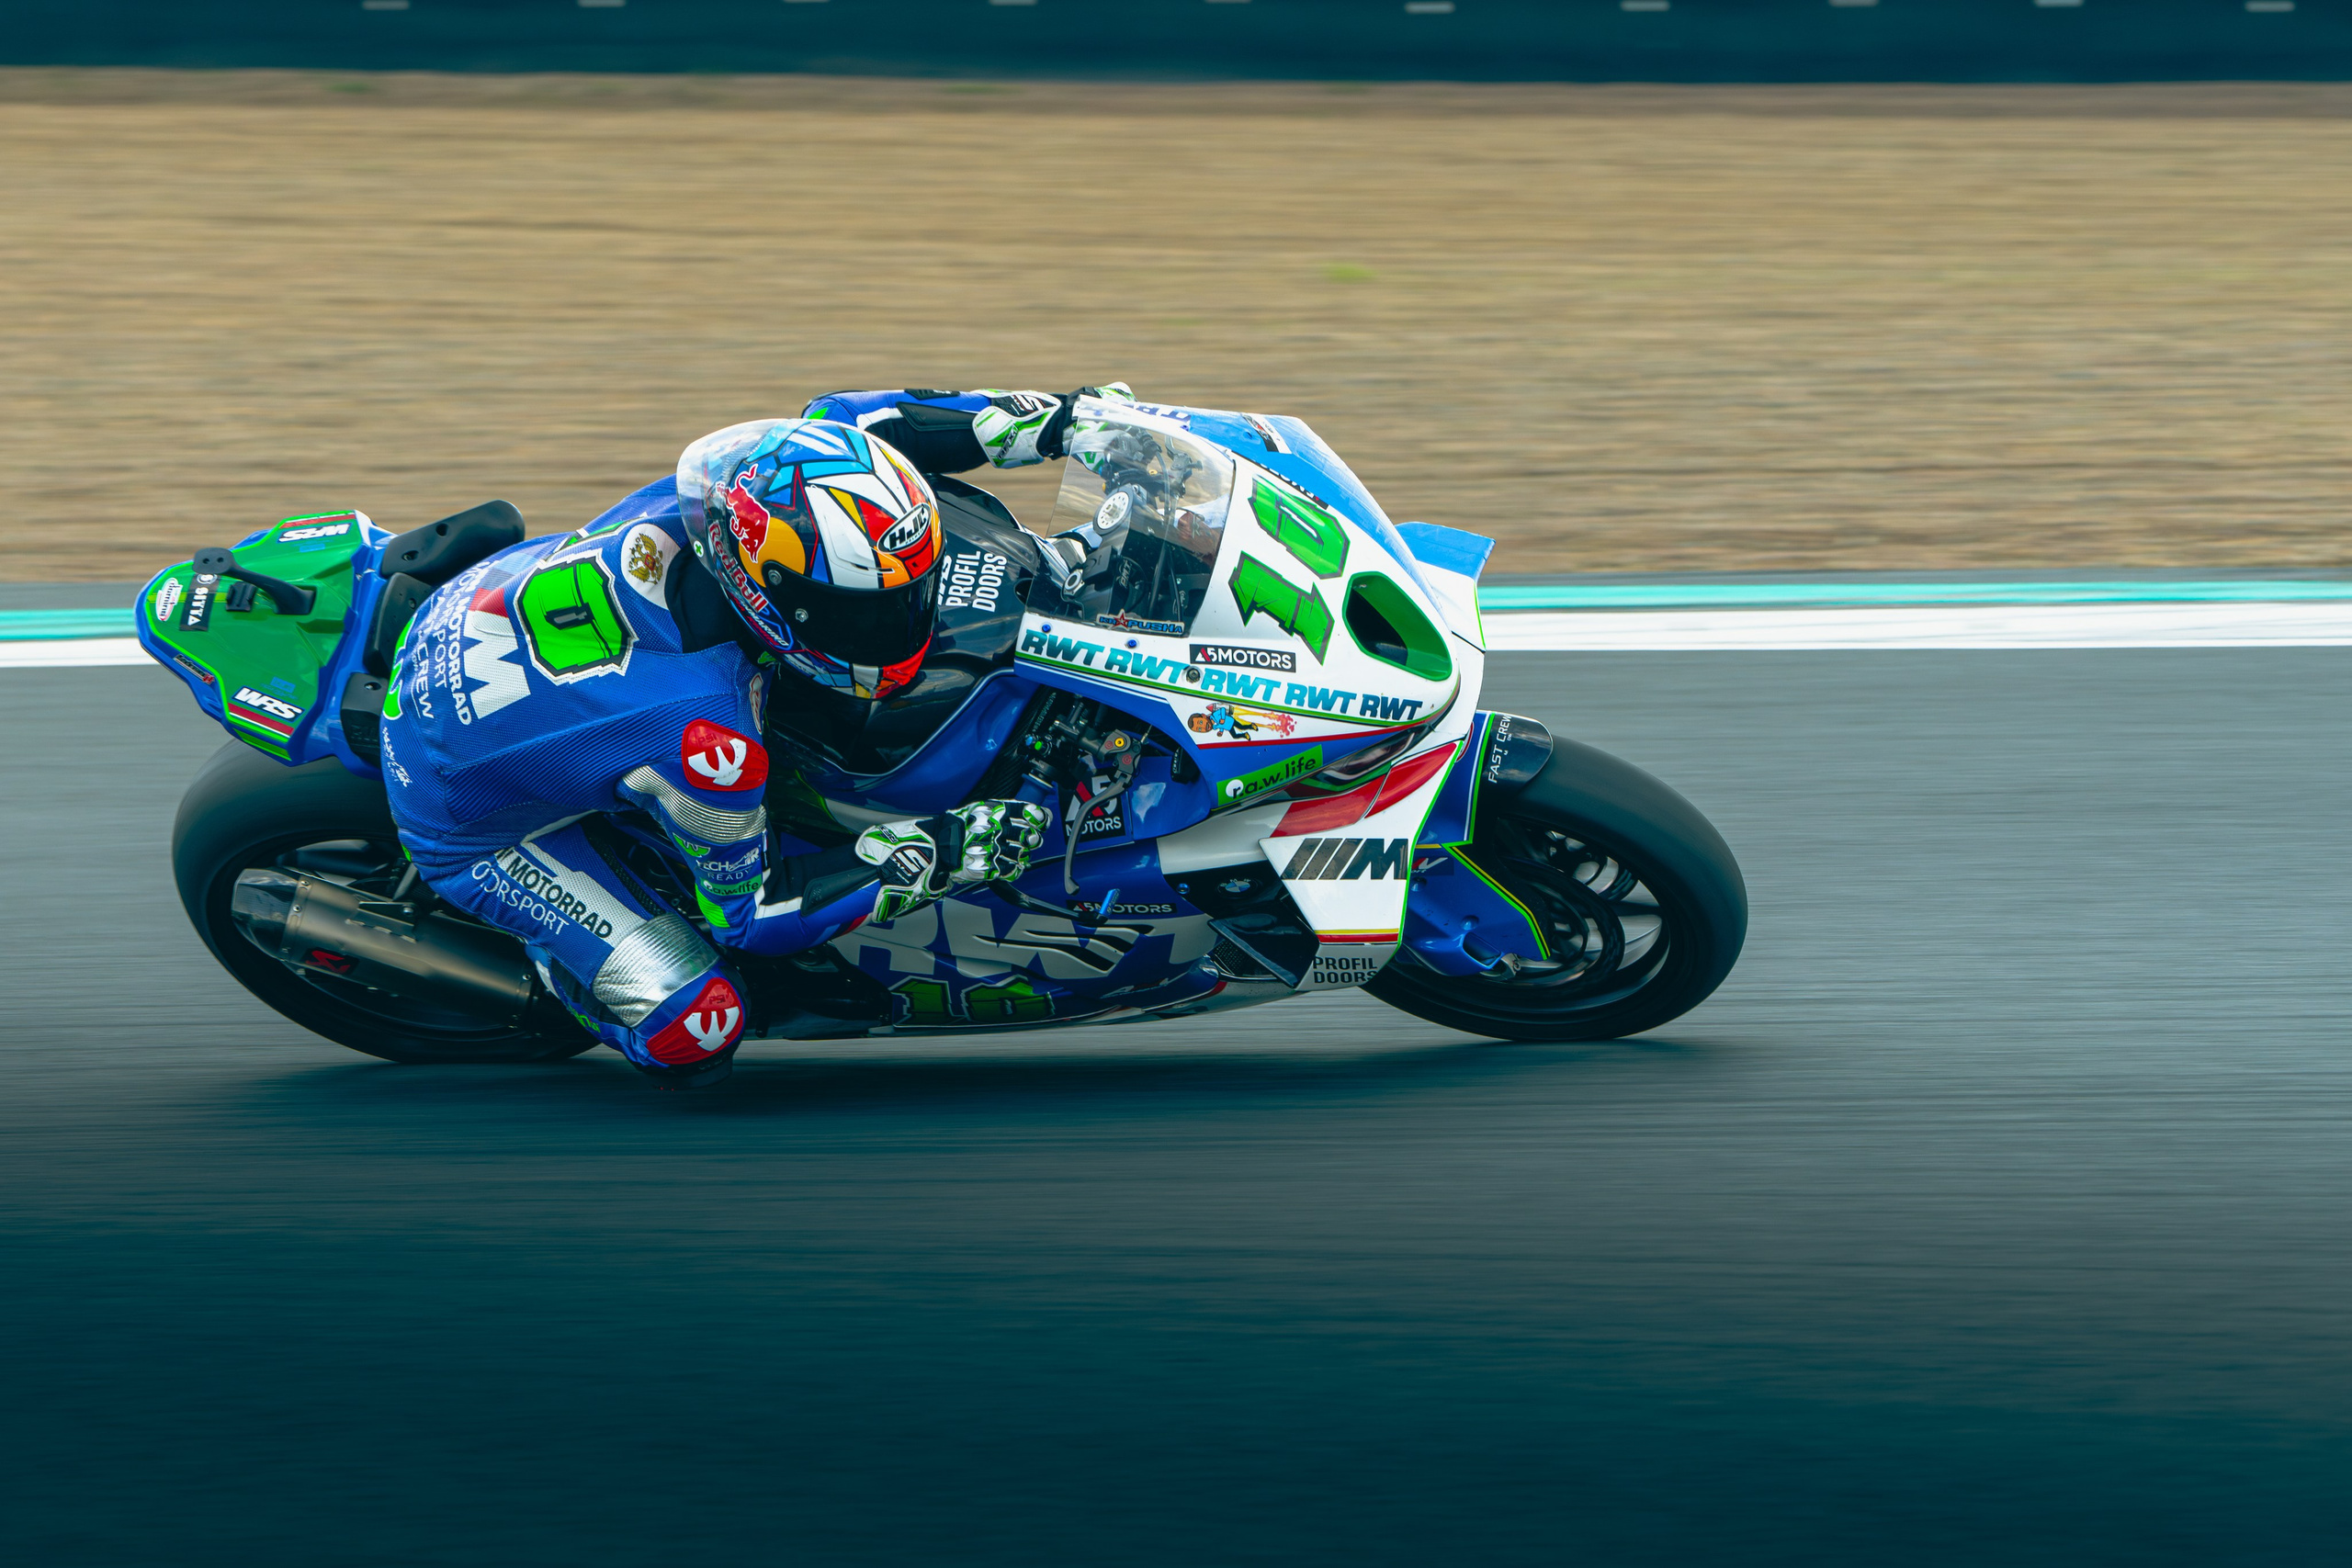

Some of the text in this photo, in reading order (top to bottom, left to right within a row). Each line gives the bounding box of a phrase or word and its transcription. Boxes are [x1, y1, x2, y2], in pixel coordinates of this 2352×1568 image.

[888, 506, 927, 550] HJC
[709, 520, 738, 570] Red
[730, 565, 769, 614] Bull
[945, 551, 980, 607] PROFIL
[972, 552, 1008, 613] DOORS
[1228, 472, 1351, 666] 10
[415, 641, 435, 719] CREW
[447, 595, 472, 726] MOTORRAD
[1021, 629, 1423, 721] RWT RWT RWT RWT RWT
[234, 687, 302, 719] WRS
[1232, 756, 1317, 799] r.a.w.life
[1488, 744, 1503, 784] FAST
[1496, 713, 1512, 742] CREW
[506, 856, 613, 939] MOTORRAD
[1313, 956, 1378, 970] PROFIL
[1313, 970, 1378, 984] DOORS
